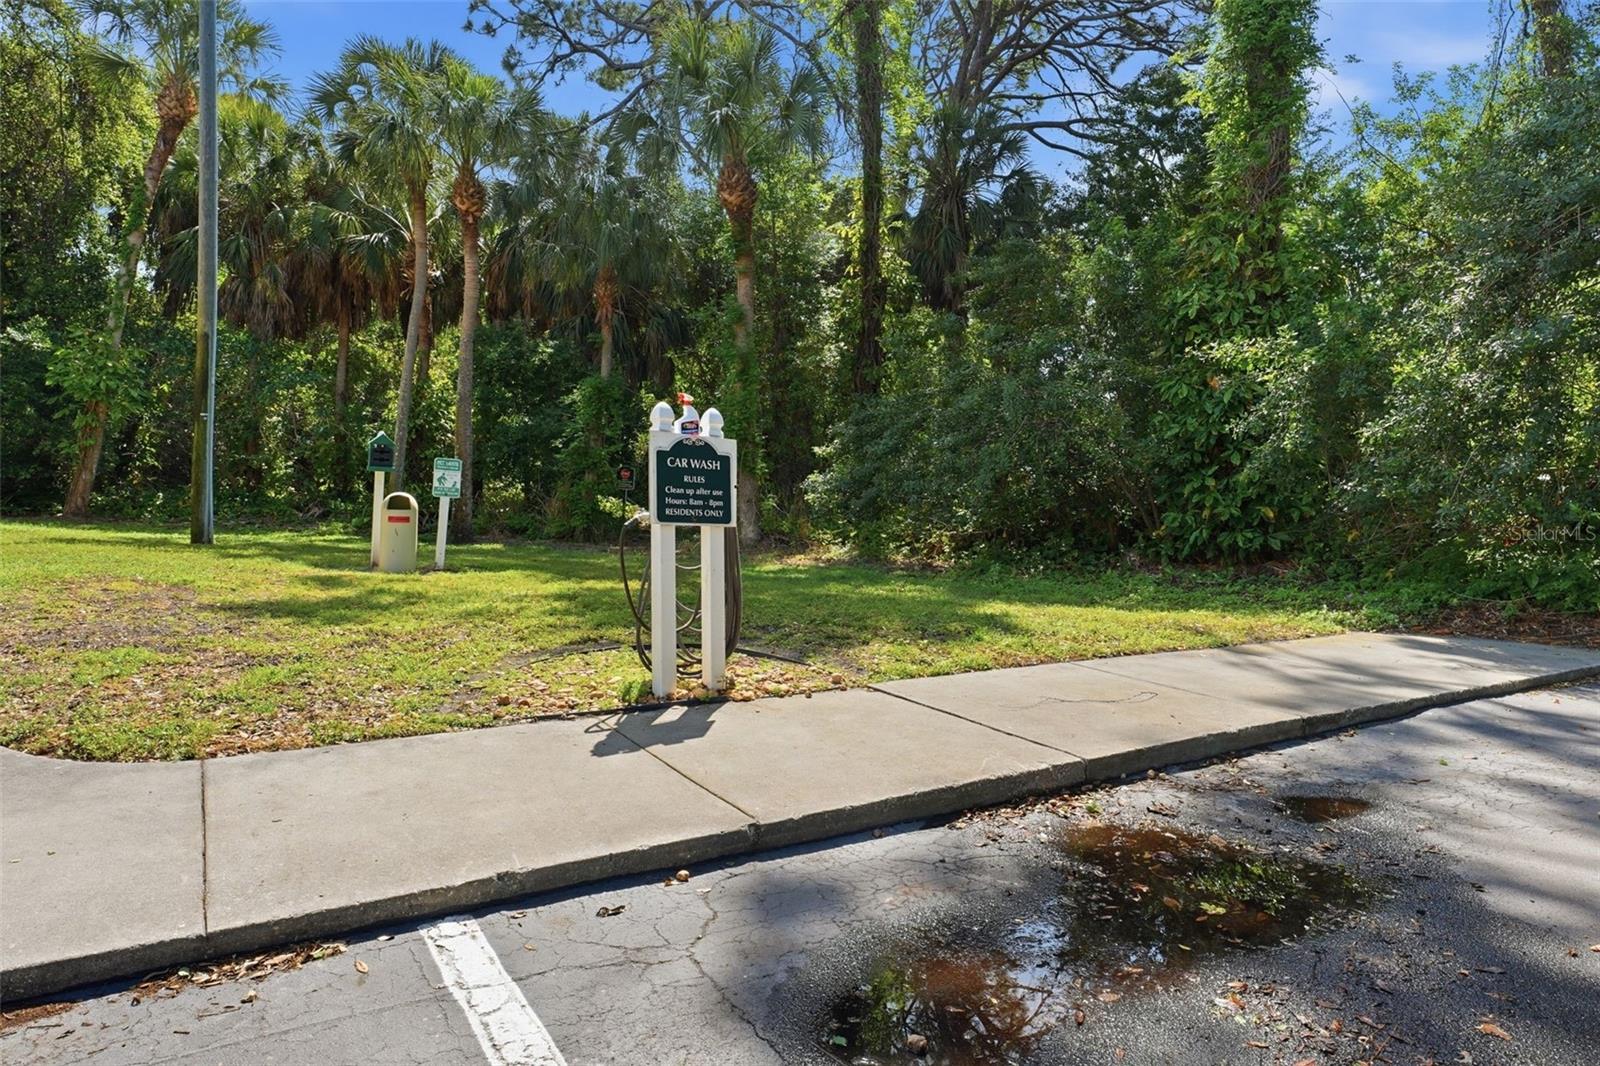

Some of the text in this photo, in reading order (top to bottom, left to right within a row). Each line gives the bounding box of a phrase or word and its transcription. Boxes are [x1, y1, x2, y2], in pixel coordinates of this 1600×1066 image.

[667, 456, 720, 470] CAR WASH
[684, 475, 706, 484] RULES
[665, 486, 684, 494] Clean
[686, 488, 694, 496] up
[696, 488, 710, 496] after
[665, 497, 688, 505] Hours:
[709, 500, 723, 508] 8pm
[665, 508, 724, 517] RESIDENTS ONLY
